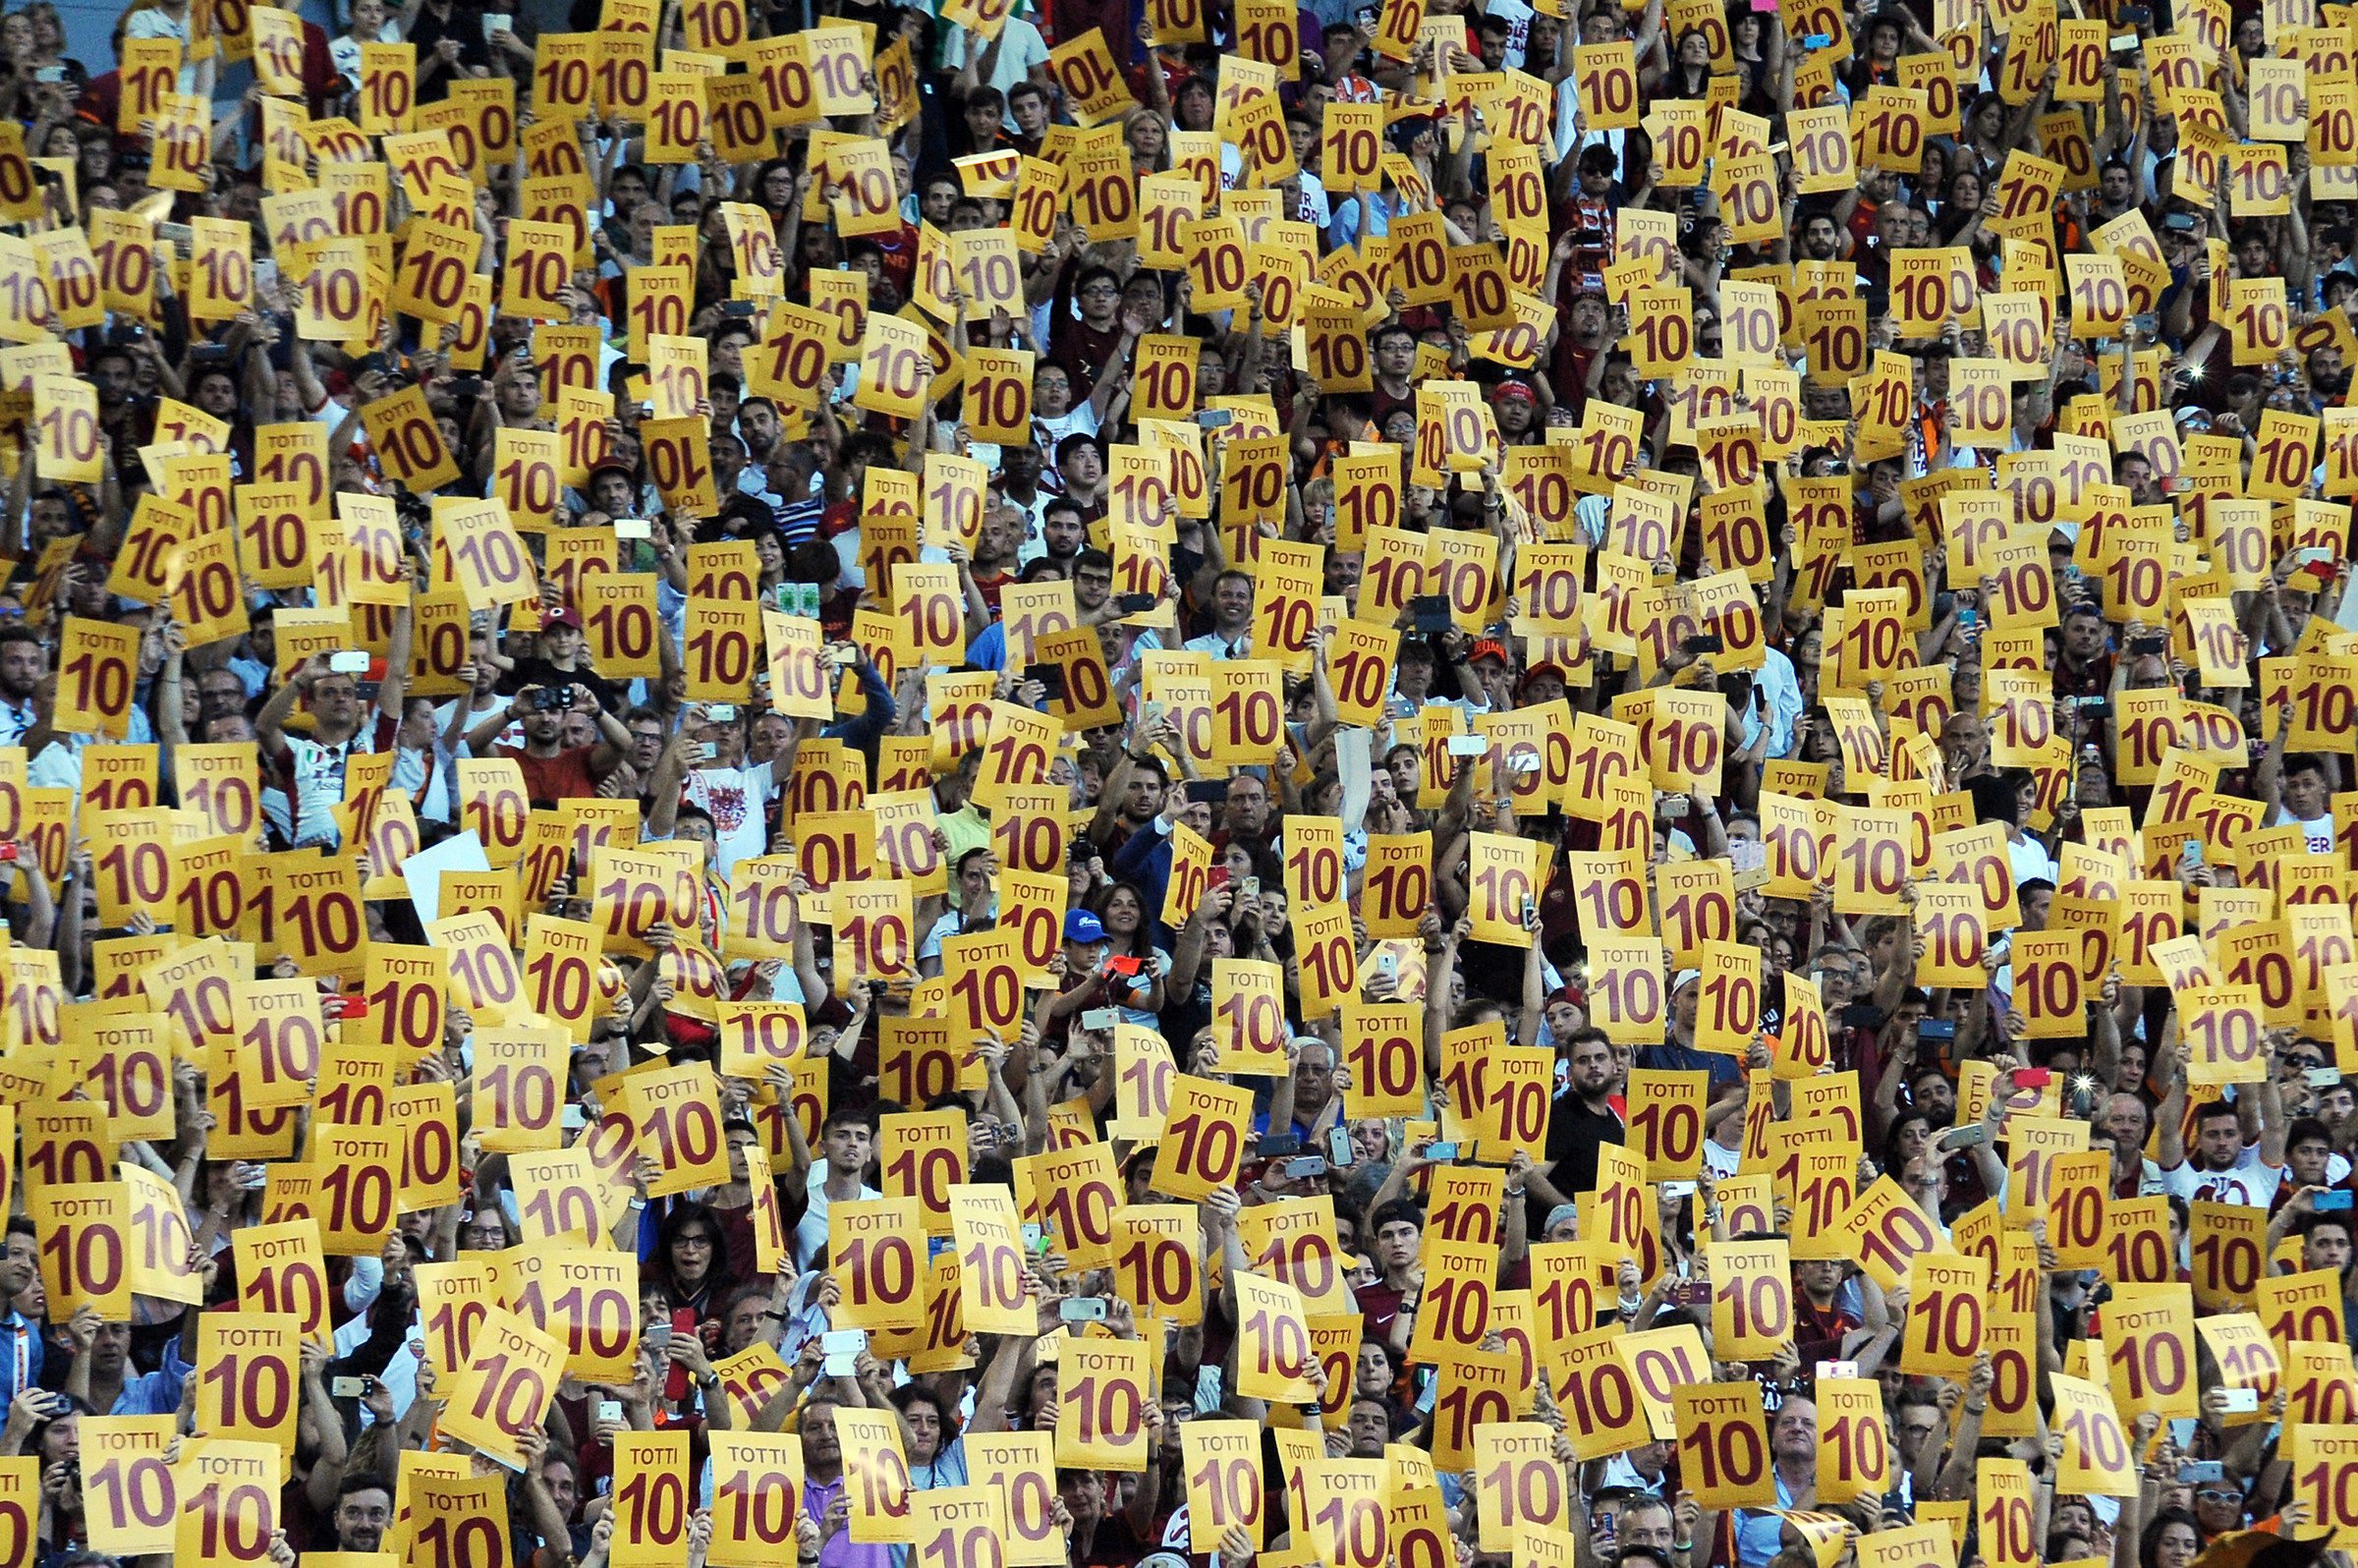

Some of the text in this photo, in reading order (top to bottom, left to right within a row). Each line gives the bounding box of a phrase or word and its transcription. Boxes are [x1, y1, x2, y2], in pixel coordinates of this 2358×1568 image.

[547, 43, 587, 55] TOTTI
[602, 41, 644, 54] TOTTI
[813, 36, 853, 50] TOTTI
[2069, 28, 2099, 39] TOTTI
[370, 53, 406, 65] TOTTI
[812, 52, 864, 98] 10
[1585, 52, 1623, 65] TOTTI
[2062, 44, 2103, 86] 10
[365, 70, 409, 118] 10
[539, 60, 589, 104] 10
[596, 59, 647, 106] 10
[1581, 69, 1632, 114] 10
[2319, 93, 2347, 105] TOTTI
[1334, 113, 1373, 125] TOTTI
[1798, 116, 1837, 130] TOTTI
[2312, 109, 2354, 151] 10
[1080, 156, 1120, 173] TOTTI
[1327, 130, 1377, 175] 10
[1794, 131, 1847, 178] 10
[1076, 176, 1131, 225] 10
[202, 229, 240, 243] TOTTI
[422, 231, 469, 252] TOTTI
[1192, 227, 1234, 243] TOTTI
[305, 251, 351, 263] TOTTI
[1190, 244, 1245, 294] 10
[1902, 259, 1940, 270] TOTTI
[197, 249, 247, 302] 10
[409, 251, 465, 308] 10
[299, 269, 361, 321] 10
[1641, 299, 1680, 310] TOTTI
[1894, 275, 1945, 321] 10
[2241, 288, 2276, 300] TOTTI
[1314, 317, 1353, 329] TOTTI
[1816, 309, 1856, 321] TOTTI
[2236, 305, 2282, 349] 10
[1636, 315, 1688, 362] 10
[1810, 326, 1862, 371] 10
[1310, 334, 1364, 379] 10
[375, 400, 417, 423] TOTTI
[2273, 420, 2309, 437] TOTTI
[378, 416, 442, 479] 10
[508, 440, 551, 456] TOTTI
[1239, 446, 1279, 461] TOTTI
[1519, 456, 1563, 469] TOTTI
[2260, 438, 2310, 488] 10
[249, 494, 296, 509] TOTTI
[500, 460, 557, 515] 10
[1229, 463, 1282, 510] 10
[1513, 473, 1570, 524] 10
[1711, 499, 1752, 516] TOTTI
[2219, 510, 2260, 522] TOTTI
[245, 514, 306, 569] 10
[1708, 517, 1764, 569] 10
[2116, 539, 2160, 553] TOTTI
[2214, 527, 2267, 574] 10
[1530, 554, 1573, 565] TOTTI
[596, 586, 644, 599] TOTTI
[1519, 569, 1577, 620] 10
[2107, 557, 2162, 607] 10
[589, 604, 651, 659] 10
[698, 610, 745, 625] TOTTI
[77, 632, 127, 653] TOTTI
[688, 630, 749, 685] 10
[1349, 632, 1387, 652] TOTTI
[66, 653, 129, 716] 10
[1224, 672, 1269, 685] TOTTI
[1334, 651, 1385, 707] 10
[2308, 664, 2351, 679] TOTTI
[1216, 692, 1278, 745] 10
[1667, 700, 1712, 716] TOTTI
[2297, 683, 2354, 734] 10
[1657, 720, 1717, 775] 10
[1005, 797, 1054, 811] TOTTI
[104, 821, 158, 837] TOTTI
[995, 816, 1060, 872] 10
[99, 843, 168, 905] 10
[287, 870, 343, 889] TOTTI
[1584, 860, 1632, 874] TOTTI
[846, 894, 898, 909] TOTTI
[1581, 878, 1643, 928] 10
[1926, 895, 1972, 907] TOTTI
[284, 892, 359, 957] 10
[541, 929, 589, 951] TOTTI
[1305, 916, 1343, 936] TOTTI
[1924, 914, 1983, 968] 10
[839, 916, 908, 975] 10
[957, 944, 1009, 963] TOTTI
[1600, 949, 1649, 963] TOTTI
[2024, 942, 2069, 957] TOTTI
[382, 958, 434, 976] TOTTI
[1303, 936, 1354, 998] 10
[1714, 954, 1751, 972] TOTTI
[247, 993, 304, 1011] TOTTI
[529, 953, 590, 1020] 10
[952, 966, 1019, 1030] 10
[1595, 969, 1658, 1024] 10
[2016, 962, 2077, 1018] 10
[2197, 994, 2247, 1005] TOTTI
[369, 981, 438, 1048] 10
[1706, 976, 1755, 1035] 10
[1356, 1017, 1407, 1032] TOTTI
[2191, 1009, 2259, 1062] 10
[243, 1016, 318, 1084] 10
[489, 1042, 546, 1058] TOTTI
[1347, 1037, 1416, 1096] 10
[480, 1065, 554, 1130] 10
[643, 1079, 700, 1101] TOTTI
[1643, 1083, 1694, 1097] TOTTI
[333, 1141, 388, 1157] TOTTI
[640, 1101, 717, 1171] 10
[1632, 1103, 1699, 1161] 10
[50, 1200, 112, 1217] TOTTI
[331, 1164, 398, 1236] 10
[844, 1213, 902, 1231] TOTTI
[1126, 1218, 1181, 1235] TOTTI
[2203, 1213, 2253, 1231] TOTTI
[43, 1224, 122, 1296] 10
[560, 1264, 620, 1282] TOTTI
[834, 1237, 914, 1305] 10
[1119, 1241, 1192, 1305] 10
[1722, 1255, 1775, 1269] TOTTI
[1927, 1267, 1975, 1285] TOTTI
[2194, 1235, 2260, 1294] 10
[553, 1287, 631, 1359] 10
[1717, 1276, 1787, 1338] 10
[1915, 1291, 1981, 1357] 10
[2115, 1310, 2171, 1330] TOTTI
[217, 1329, 281, 1346] TOTTI
[1560, 1341, 1615, 1368] TOTTI
[1076, 1354, 1134, 1372] TOTTI
[2111, 1332, 2186, 1399] 10
[204, 1355, 290, 1428] 10
[1556, 1365, 1633, 1435] 10
[1688, 1397, 1747, 1415] TOTTI
[1831, 1393, 1873, 1409] TOTTI
[1065, 1377, 1143, 1445] 10
[630, 1448, 677, 1465] TOTTI
[727, 1446, 786, 1464] TOTTI
[1198, 1435, 1249, 1452] TOTTI
[1684, 1421, 1763, 1487] 10
[1824, 1417, 1883, 1482] 10
[1193, 1459, 1260, 1526] 10
[1991, 1474, 2022, 1488] TOTTI
[619, 1473, 683, 1544] 10
[719, 1471, 797, 1543] 10
[1985, 1496, 2035, 1563] 10
